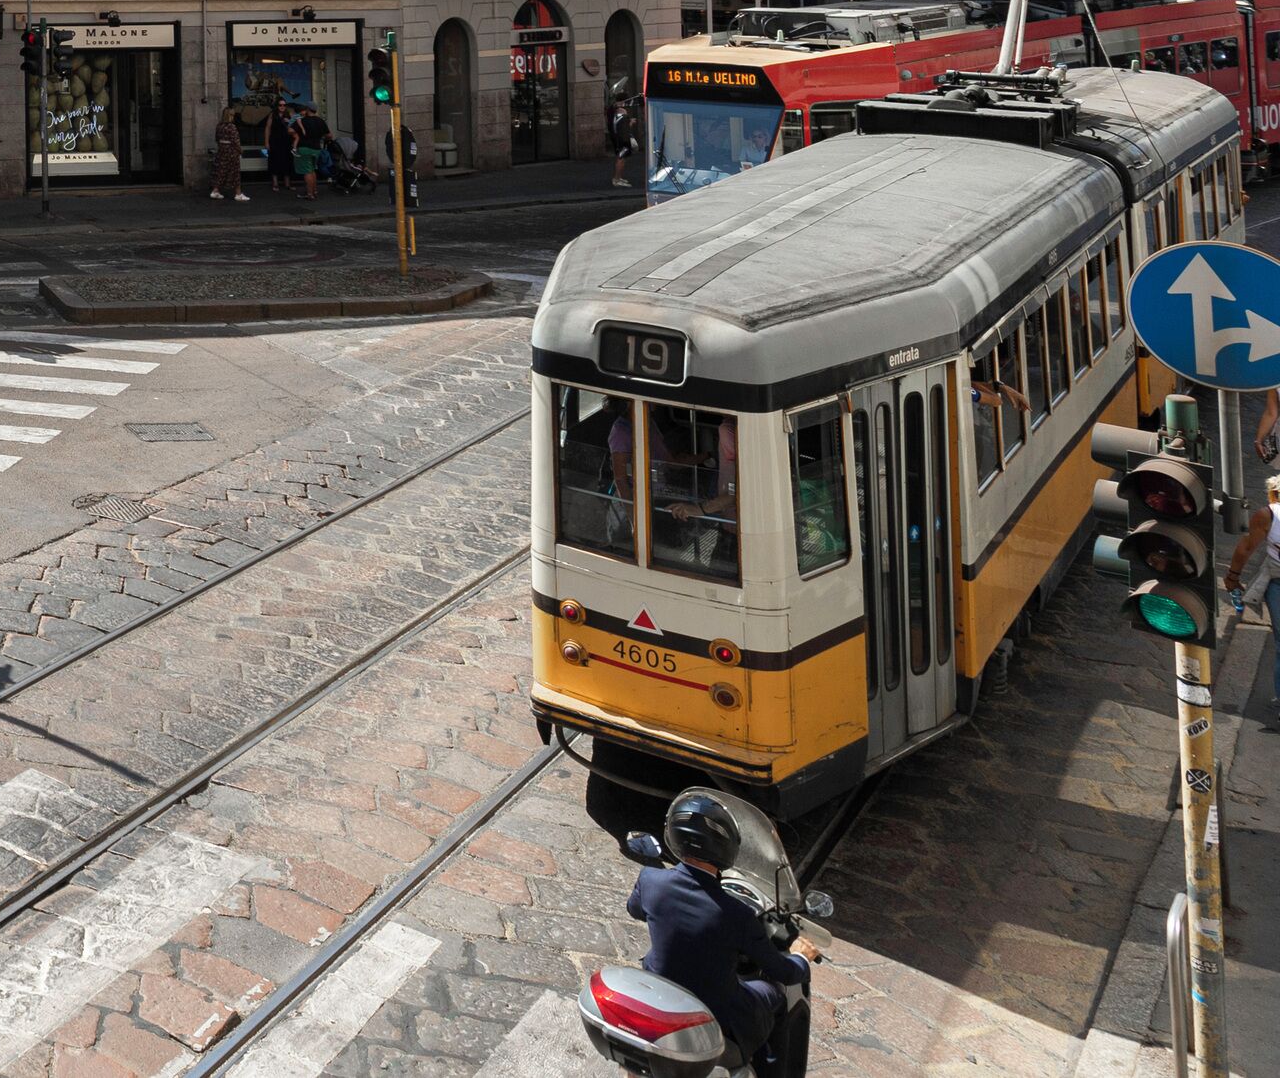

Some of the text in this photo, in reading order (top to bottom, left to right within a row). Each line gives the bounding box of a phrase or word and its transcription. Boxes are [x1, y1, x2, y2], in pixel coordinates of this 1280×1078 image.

[668, 70, 682, 82] 16
[713, 72, 757, 86] VELINO
[626, 335, 669, 375] 19
[888, 346, 920, 367] entrata
[613, 640, 676, 673] 4605
[1187, 719, 1210, 737] KOKO
